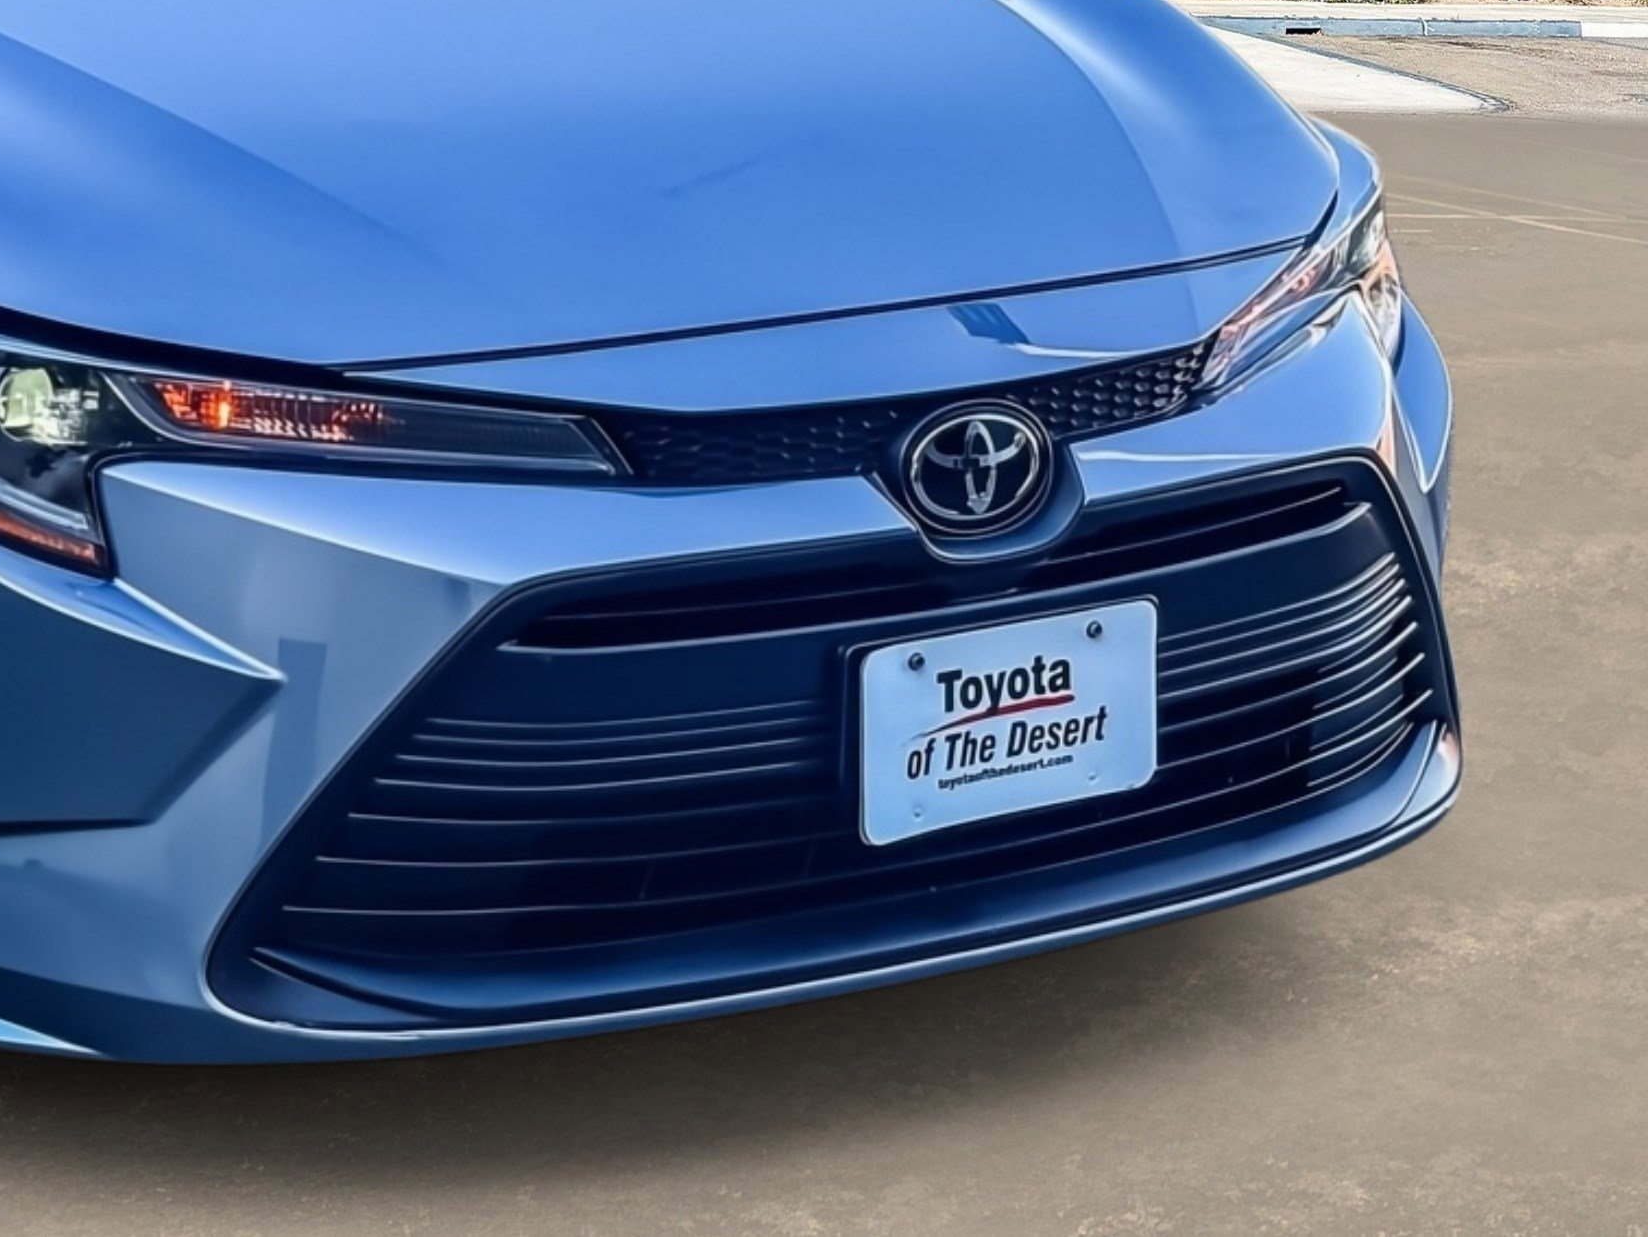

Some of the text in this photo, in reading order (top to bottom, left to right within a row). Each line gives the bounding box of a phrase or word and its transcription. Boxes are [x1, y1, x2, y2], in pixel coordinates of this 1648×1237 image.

[936, 655, 1072, 712] Toyota
[906, 705, 1107, 780] of The Desert
[937, 754, 1074, 791] toyotaofthedesert.com
